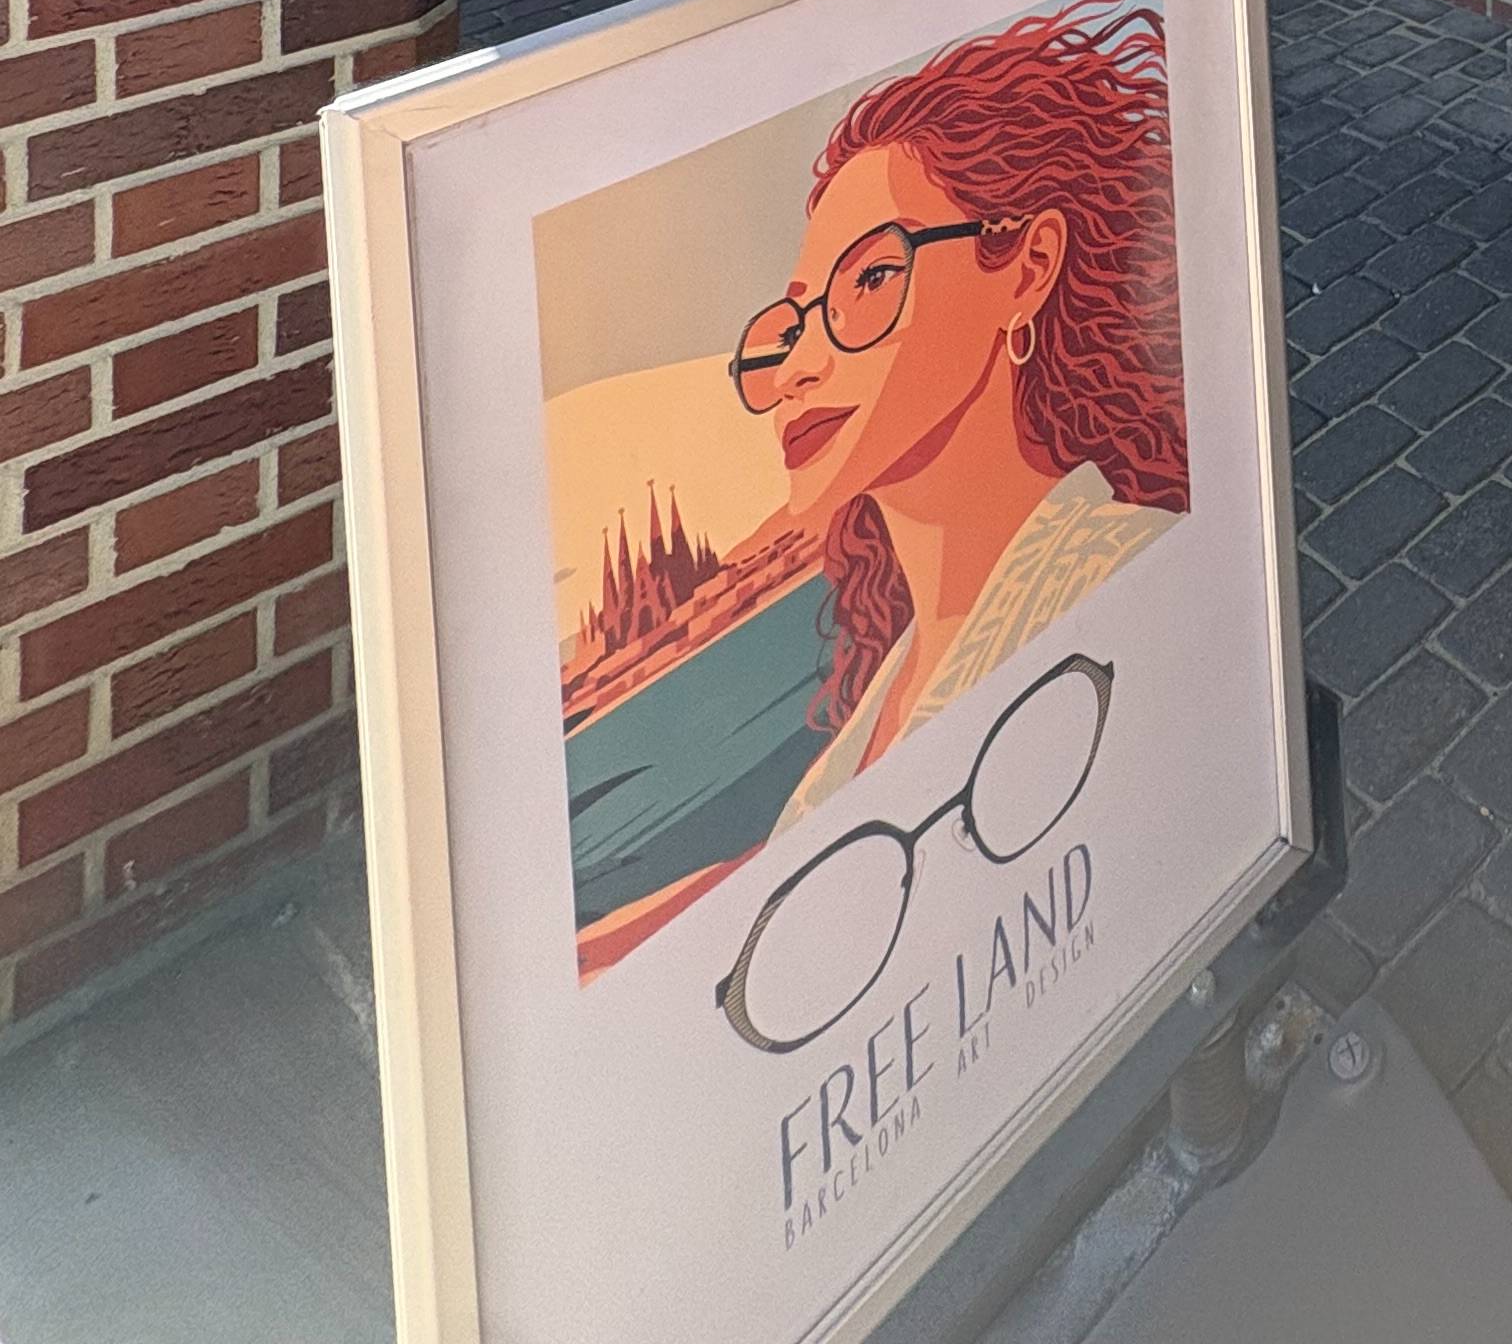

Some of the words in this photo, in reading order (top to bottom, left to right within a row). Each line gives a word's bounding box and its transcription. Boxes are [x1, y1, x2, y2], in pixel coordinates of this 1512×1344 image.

[781, 981, 935, 1212] FREE
[955, 843, 1092, 1039] LAND
[784, 1095, 922, 1251] BARCELONA
[956, 1021, 992, 1079] ART
[1025, 920, 1095, 1009] DESIGN
